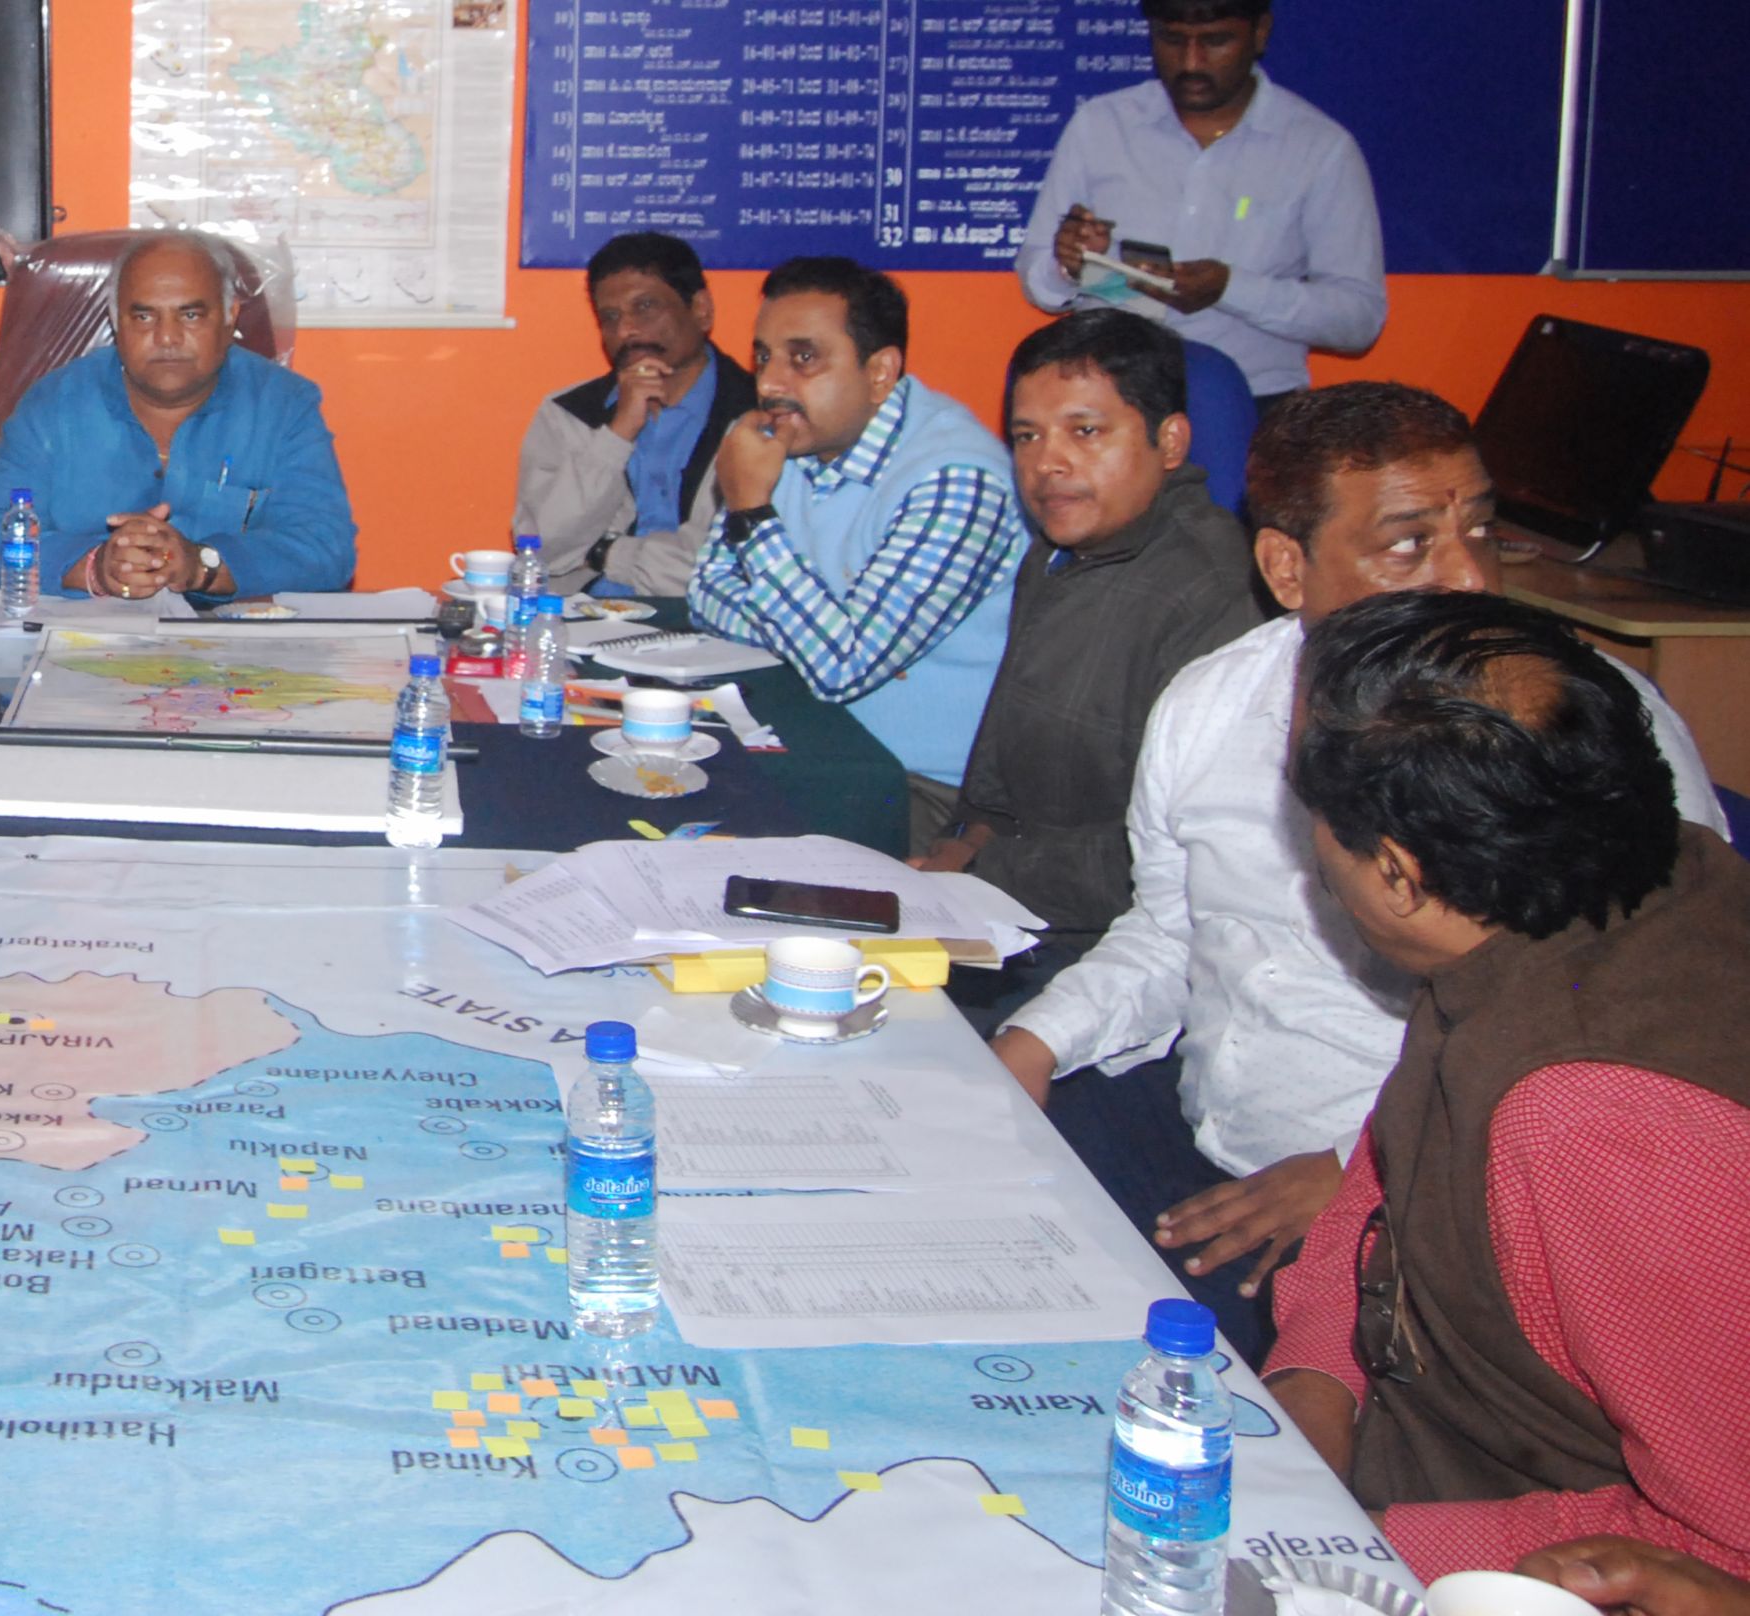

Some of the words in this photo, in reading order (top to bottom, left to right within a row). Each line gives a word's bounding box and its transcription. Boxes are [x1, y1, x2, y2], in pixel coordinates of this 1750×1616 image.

[885, 168, 903, 186] 30
[884, 203, 899, 222] 31
[879, 226, 903, 247] 32
[397, 983, 543, 1034] STATE
[265, 1067, 478, 1088] Cheyyandane
[175, 1102, 286, 1119] Parane
[425, 1098, 564, 1114] Kokkabe
[229, 1139, 368, 1161] Napoklu
[124, 1177, 258, 1199] Murnad
[250, 1262, 427, 1289] Bettageri
[387, 1314, 571, 1341] Madenad
[501, 1363, 722, 1389] MADIKERI
[49, 1372, 280, 1404] Makkandur
[970, 1391, 1105, 1416] Karike
[1244, 1531, 1394, 1562] Peraje
